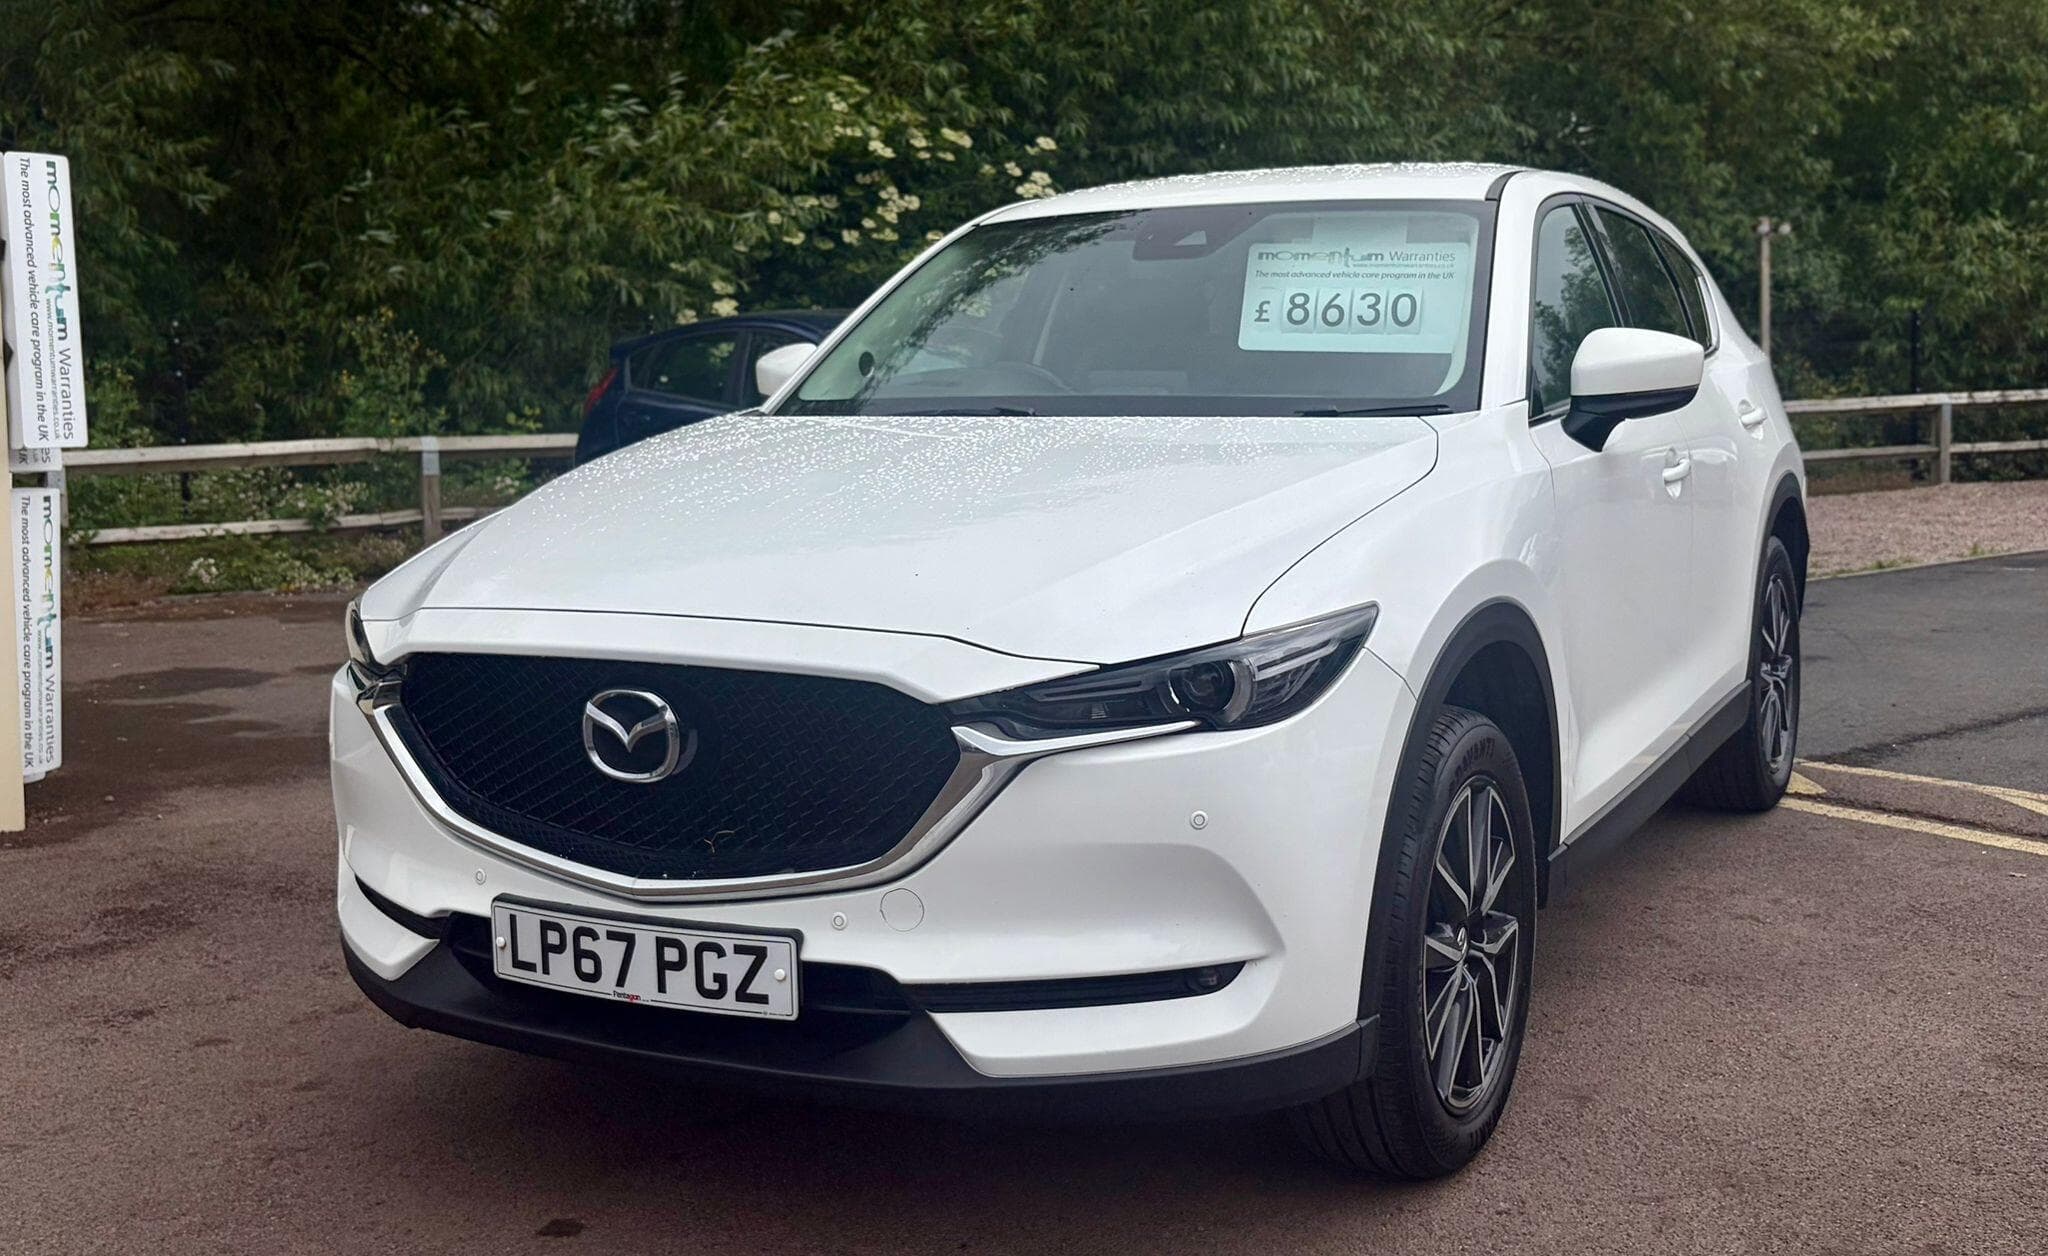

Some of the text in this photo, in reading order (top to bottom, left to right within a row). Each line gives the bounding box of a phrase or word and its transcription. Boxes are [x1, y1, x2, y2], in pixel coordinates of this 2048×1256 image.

[20, 157, 31, 178] The
[21, 180, 32, 208] most
[24, 210, 37, 268] advanced
[1257, 247, 1456, 268] momentum Warranties
[1256, 269, 1269, 278] The
[1291, 270, 1332, 278] advanced
[1332, 270, 1360, 278] vehicle
[1380, 272, 1417, 280] program
[1418, 271, 1426, 279] in
[1427, 271, 1441, 279] the
[28, 270, 40, 309] vehicle
[45, 160, 76, 440] momentum Warranties
[31, 311, 39, 337] care
[30, 339, 43, 389] program
[36, 391, 46, 401] in
[37, 404, 47, 422] the
[38, 424, 49, 441] UK
[21, 496, 34, 768] The most advanced vehicle care program in the UK
[37, 495, 57, 763] momentum Warranties
[509, 913, 769, 1005] LP67 PGZ
